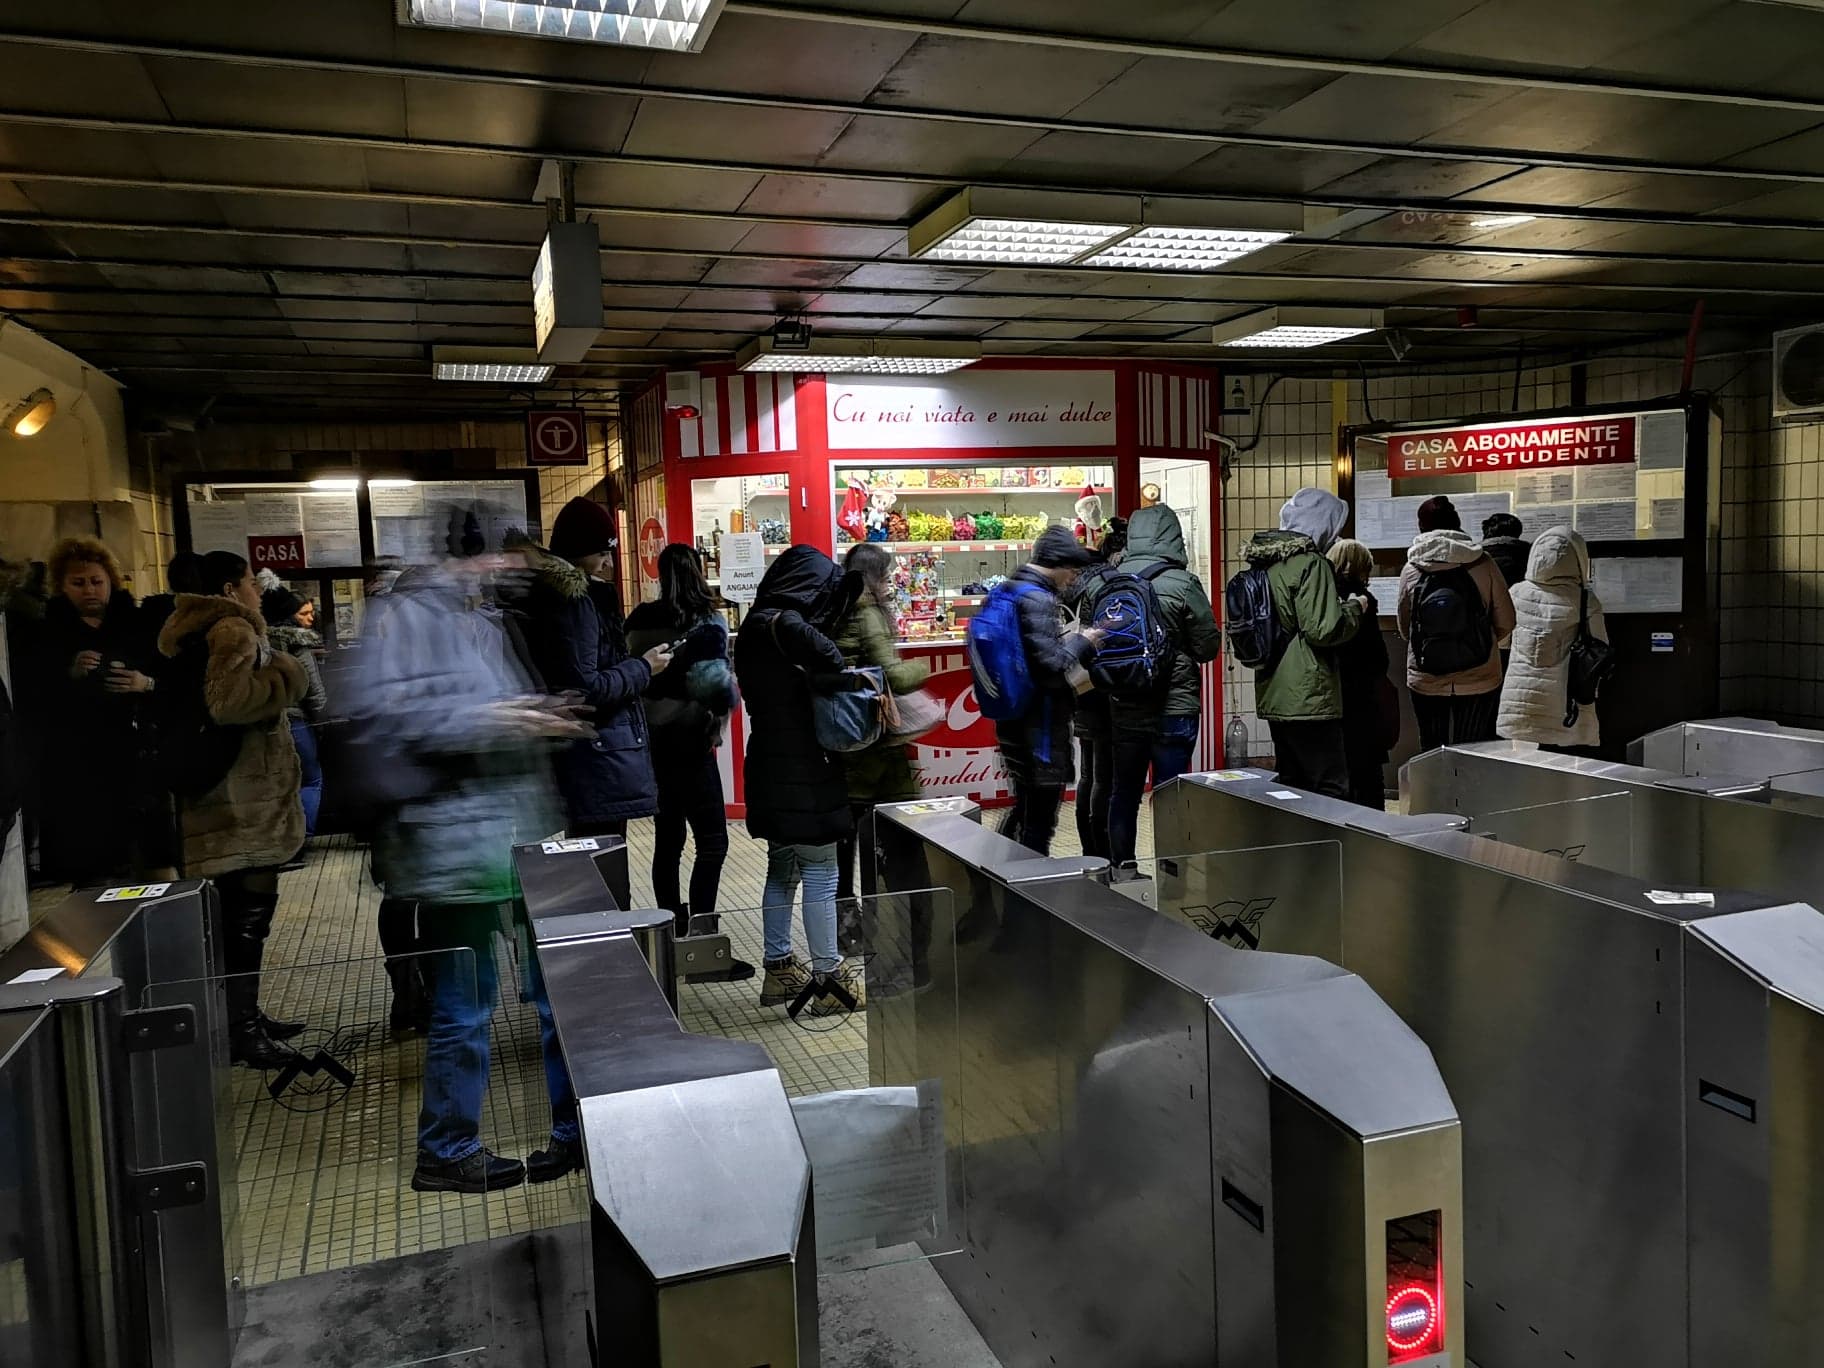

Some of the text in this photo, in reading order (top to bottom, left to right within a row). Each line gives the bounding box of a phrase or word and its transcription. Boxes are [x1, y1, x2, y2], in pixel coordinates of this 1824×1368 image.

[833, 393, 865, 422] Cu
[878, 404, 914, 423] noi
[987, 409, 998, 423] e
[1008, 404, 1049, 423] mai
[1060, 400, 1113, 422] dulce
[1401, 437, 1459, 456] CASA
[1462, 424, 1620, 452] ABONAMENTE
[1404, 445, 1617, 472] ELEVI-STUDENTI
